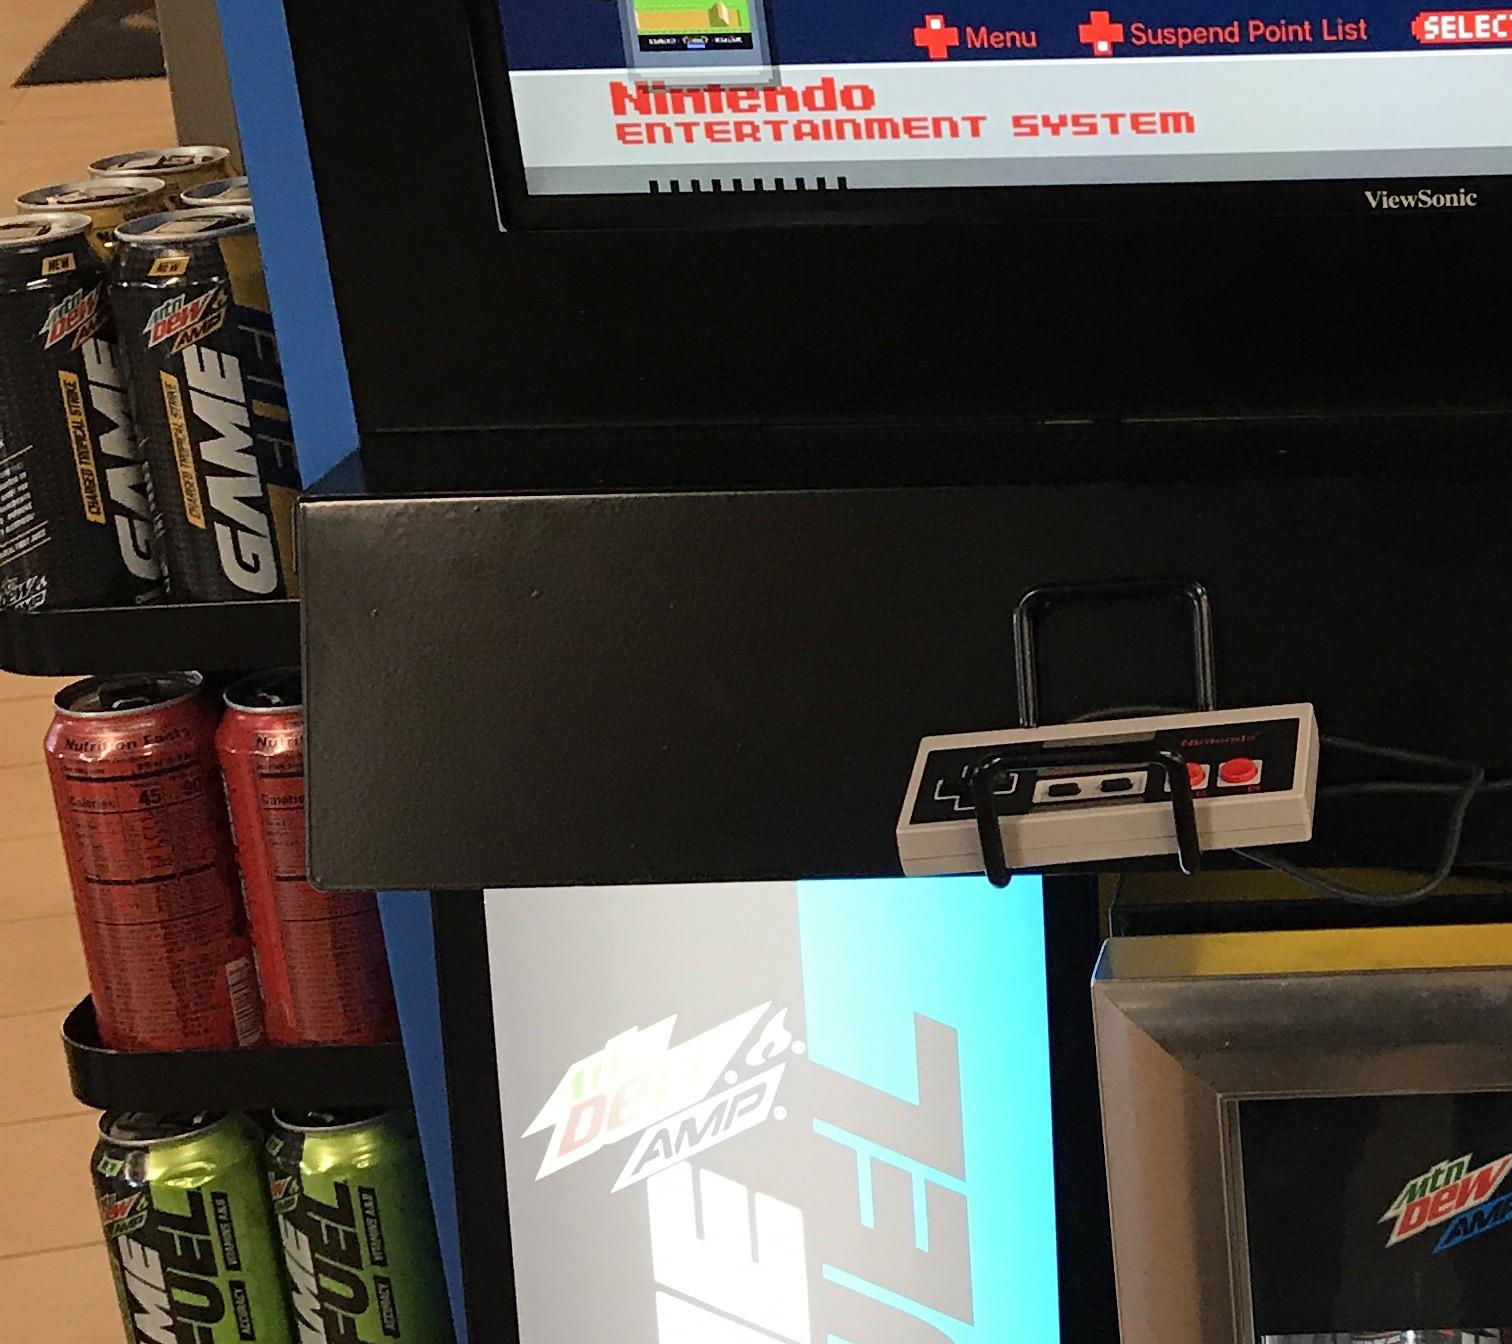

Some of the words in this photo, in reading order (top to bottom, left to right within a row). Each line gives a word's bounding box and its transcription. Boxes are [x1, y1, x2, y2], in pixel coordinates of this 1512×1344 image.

[966, 26, 1037, 49] Menu
[1130, 21, 1240, 50] Suspend
[1248, 18, 1314, 44] Point
[1323, 15, 1369, 42] List
[608, 75, 877, 116] Nintendo
[614, 114, 988, 145] ENTERTAINMENT
[1011, 110, 1197, 138] SYSTEM
[1364, 187, 1480, 212] ViewSonic
[183, 344, 278, 594] GAME
[631, 1081, 767, 1177] AMP
[1399, 1159, 1466, 1208] Mtn
[233, 1287, 252, 1335] ACCURACY
